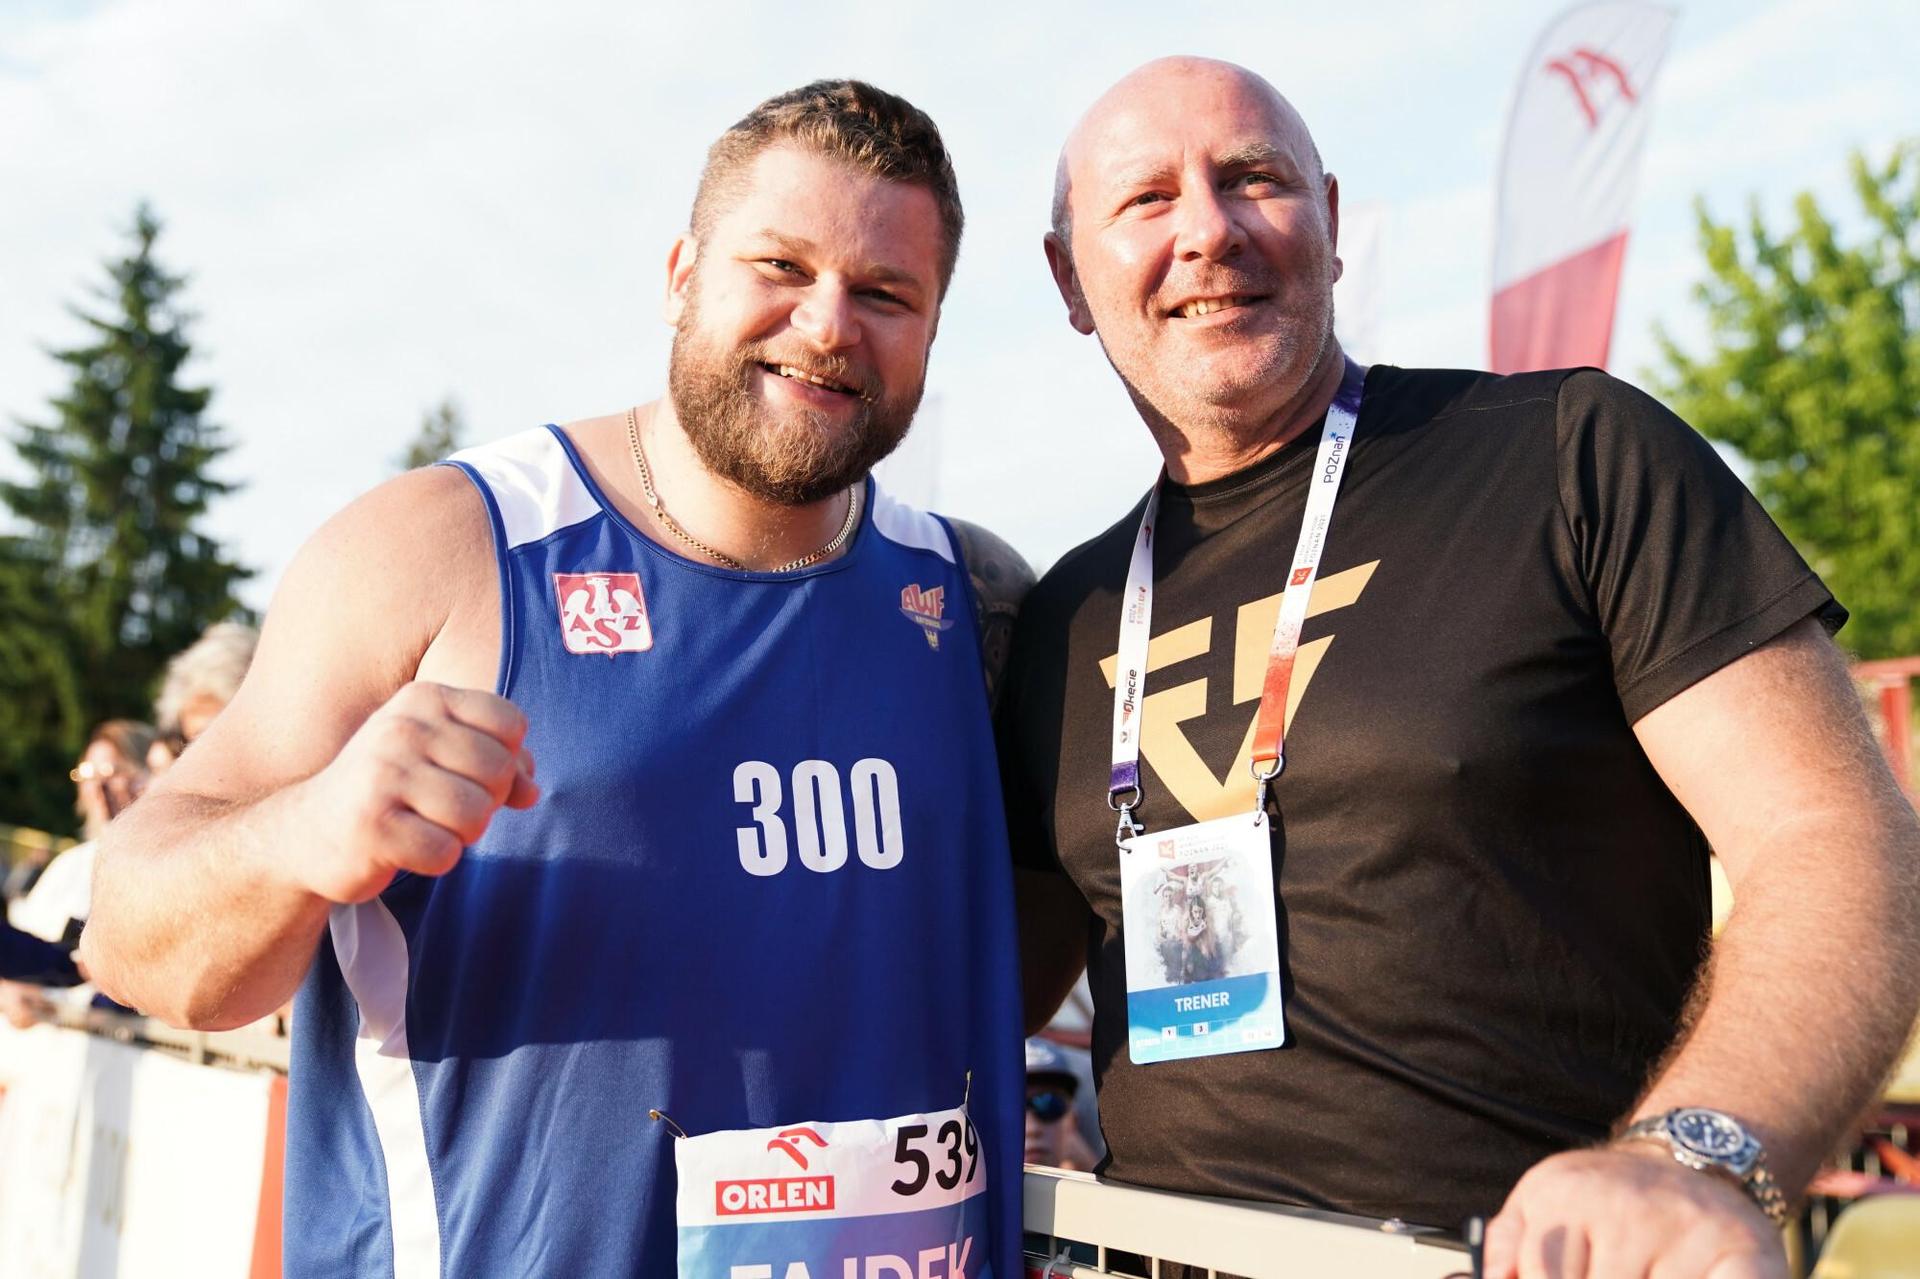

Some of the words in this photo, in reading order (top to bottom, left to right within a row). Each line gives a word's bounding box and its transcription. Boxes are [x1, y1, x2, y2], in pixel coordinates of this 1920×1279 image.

[901, 583, 944, 619] AWF
[732, 757, 905, 877] 300
[1174, 991, 1230, 1013] TRENER
[891, 1119, 979, 1197] 539
[721, 1180, 829, 1211] ORLEN
[730, 1236, 973, 1279] DEK
